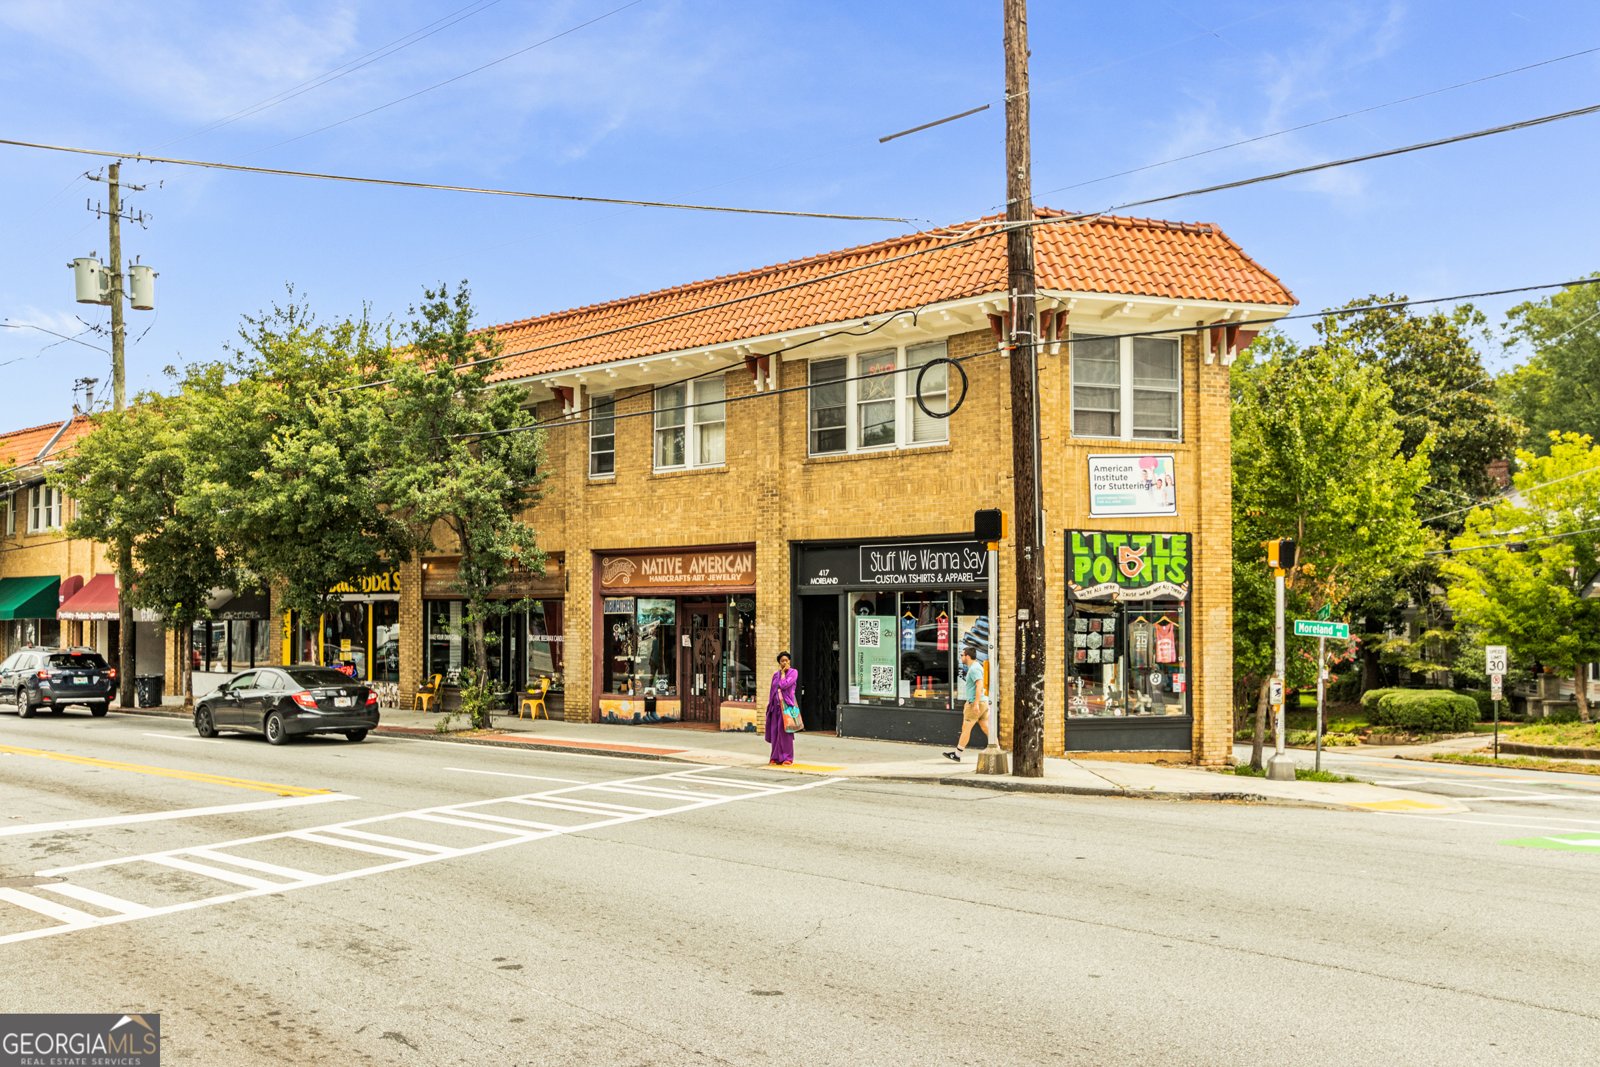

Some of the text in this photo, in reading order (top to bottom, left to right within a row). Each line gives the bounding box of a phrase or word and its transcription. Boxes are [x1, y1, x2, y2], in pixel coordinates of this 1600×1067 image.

[1108, 482, 1150, 491] Stuttering
[1071, 533, 1187, 557] LITTLE
[641, 554, 752, 575] NATIVE AMERICAN
[870, 548, 987, 574] Stuff We Wanna Say
[1118, 545, 1147, 578] 5
[649, 574, 691, 582] HANDCRAFTS
[707, 573, 742, 582] JEWELRY
[818, 569, 830, 577] 417
[875, 572, 975, 584] CUSTOM TSHIRTS & APPAREL
[810, 577, 838, 585] MORELAND
[1298, 622, 1333, 635] Moreland
[1489, 660, 1505, 671] 30
